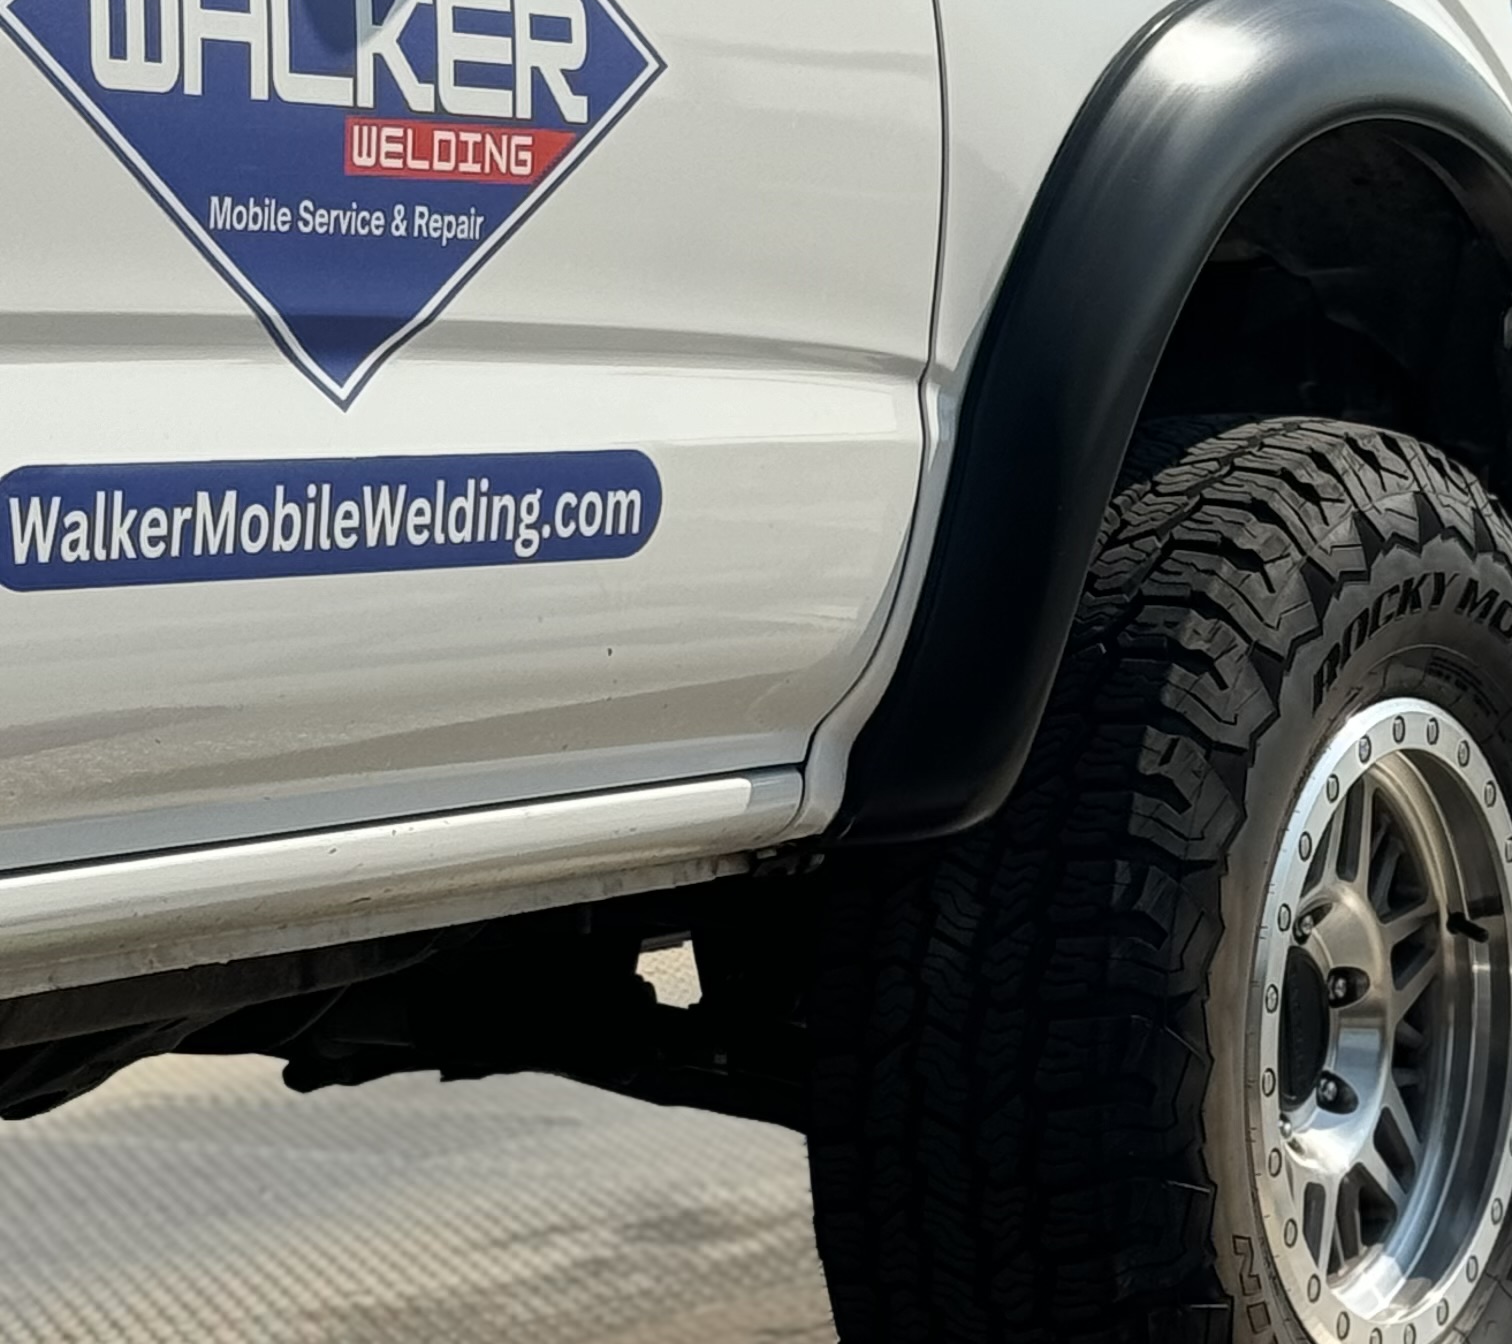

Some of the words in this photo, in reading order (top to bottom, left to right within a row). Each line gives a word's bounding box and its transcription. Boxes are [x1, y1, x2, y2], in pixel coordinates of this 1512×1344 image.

[352, 124, 533, 176] WELDING
[209, 195, 292, 232] Mobile
[298, 199, 386, 236] Service
[391, 204, 408, 238] &
[412, 205, 485, 246] Repair
[9, 478, 641, 565] WalkerMobileWelding.com
[1312, 571, 1461, 718] ROCKY
